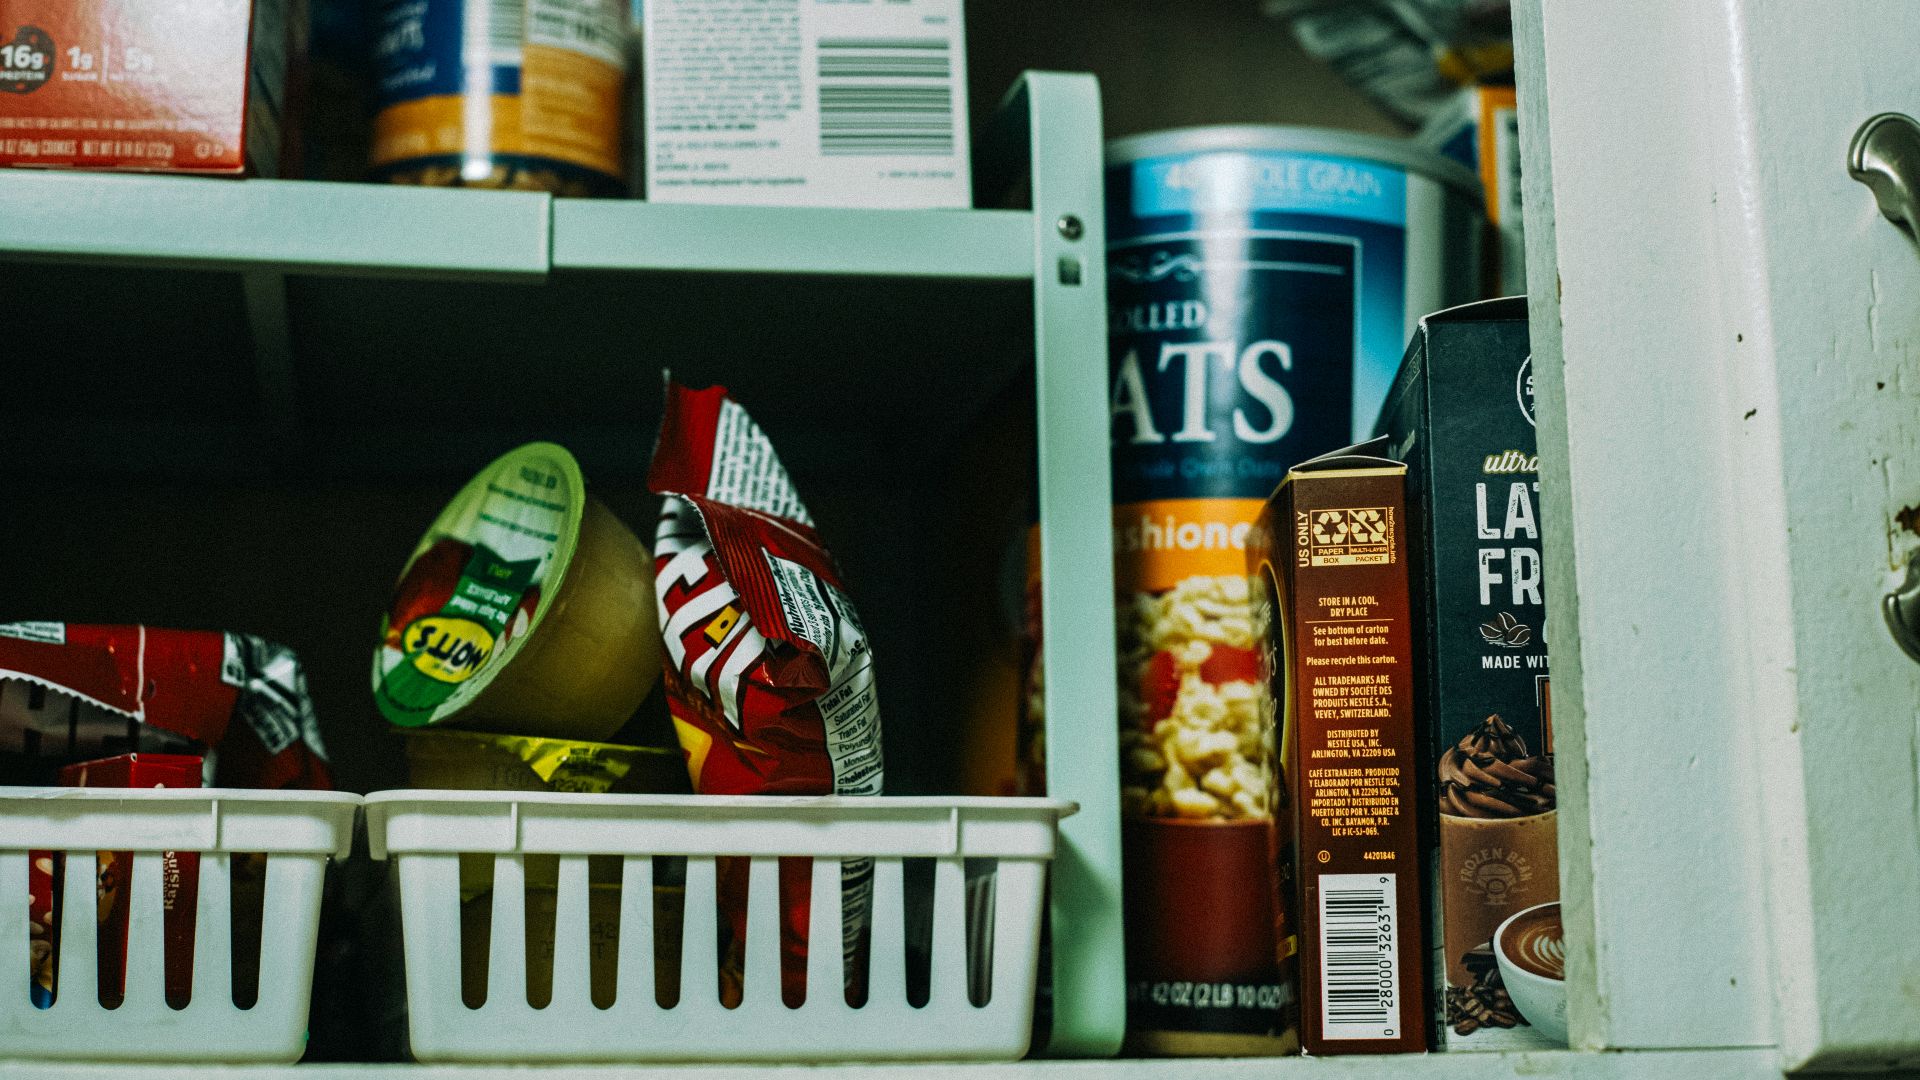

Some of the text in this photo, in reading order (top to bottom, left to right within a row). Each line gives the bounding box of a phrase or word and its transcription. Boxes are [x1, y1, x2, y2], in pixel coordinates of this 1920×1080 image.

[1108, 340, 1294, 443] ATS
[1297, 511, 1310, 567] US ONLY
[1318, 548, 1344, 556] PAPER
[1318, 596, 1378, 606] STORE IN A COOL,
[1330, 607, 1368, 617] DRY PLACE
[1313, 625, 1388, 636] See bottom of carton
[1314, 636, 1388, 646] for best before date.
[1306, 655, 1398, 666] Please recycle this carton.
[1482, 655, 1520, 669] MADE
[1314, 675, 1390, 686] ALL TRADEMARKS ARE
[1312, 685, 1392, 696] OWNED BY SOCIÉTÉ DES
[1313, 698, 1348, 708] PRODUITS
[1349, 696, 1374, 706] NESTLÉ
[1314, 708, 1391, 720] VEVEY, SWITZERLAND.
[1326, 729, 1379, 738] DISTRIBUTED BY
[1328, 738, 1350, 748] NESTLÉ
[1368, 739, 1382, 747] INC.
[1312, 748, 1396, 758] ARLINGTON, VA 22209 USA
[1308, 768, 1322, 778] CAFÉ
[1365, 768, 1400, 776] PRODUCIDO
[1308, 779, 1313, 787] Y
[1314, 779, 1349, 787] ELABORADO
[1350, 778, 1362, 786] POR
[1364, 777, 1384, 786] NESTLÉ
[1316, 789, 1351, 797] ARLINGTON,
[1352, 788, 1360, 796] VA
[1361, 788, 1378, 796] 22209
[1312, 798, 1346, 807] IMPORTADO
[1347, 798, 1351, 806] Y
[1352, 798, 1390, 806] DISTRIBUIDO
[1312, 808, 1334, 816] PUERTO
[1336, 808, 1349, 816] RICO
[1350, 808, 1362, 816] POR
[1371, 808, 1393, 816] SUAREZ
[1332, 828, 1341, 836] LIC
[1364, 852, 1396, 860] 44201846
[1378, 905, 1392, 952] 32631
[1379, 960, 1394, 1008] 28000
[1384, 1028, 1394, 1036] 0
